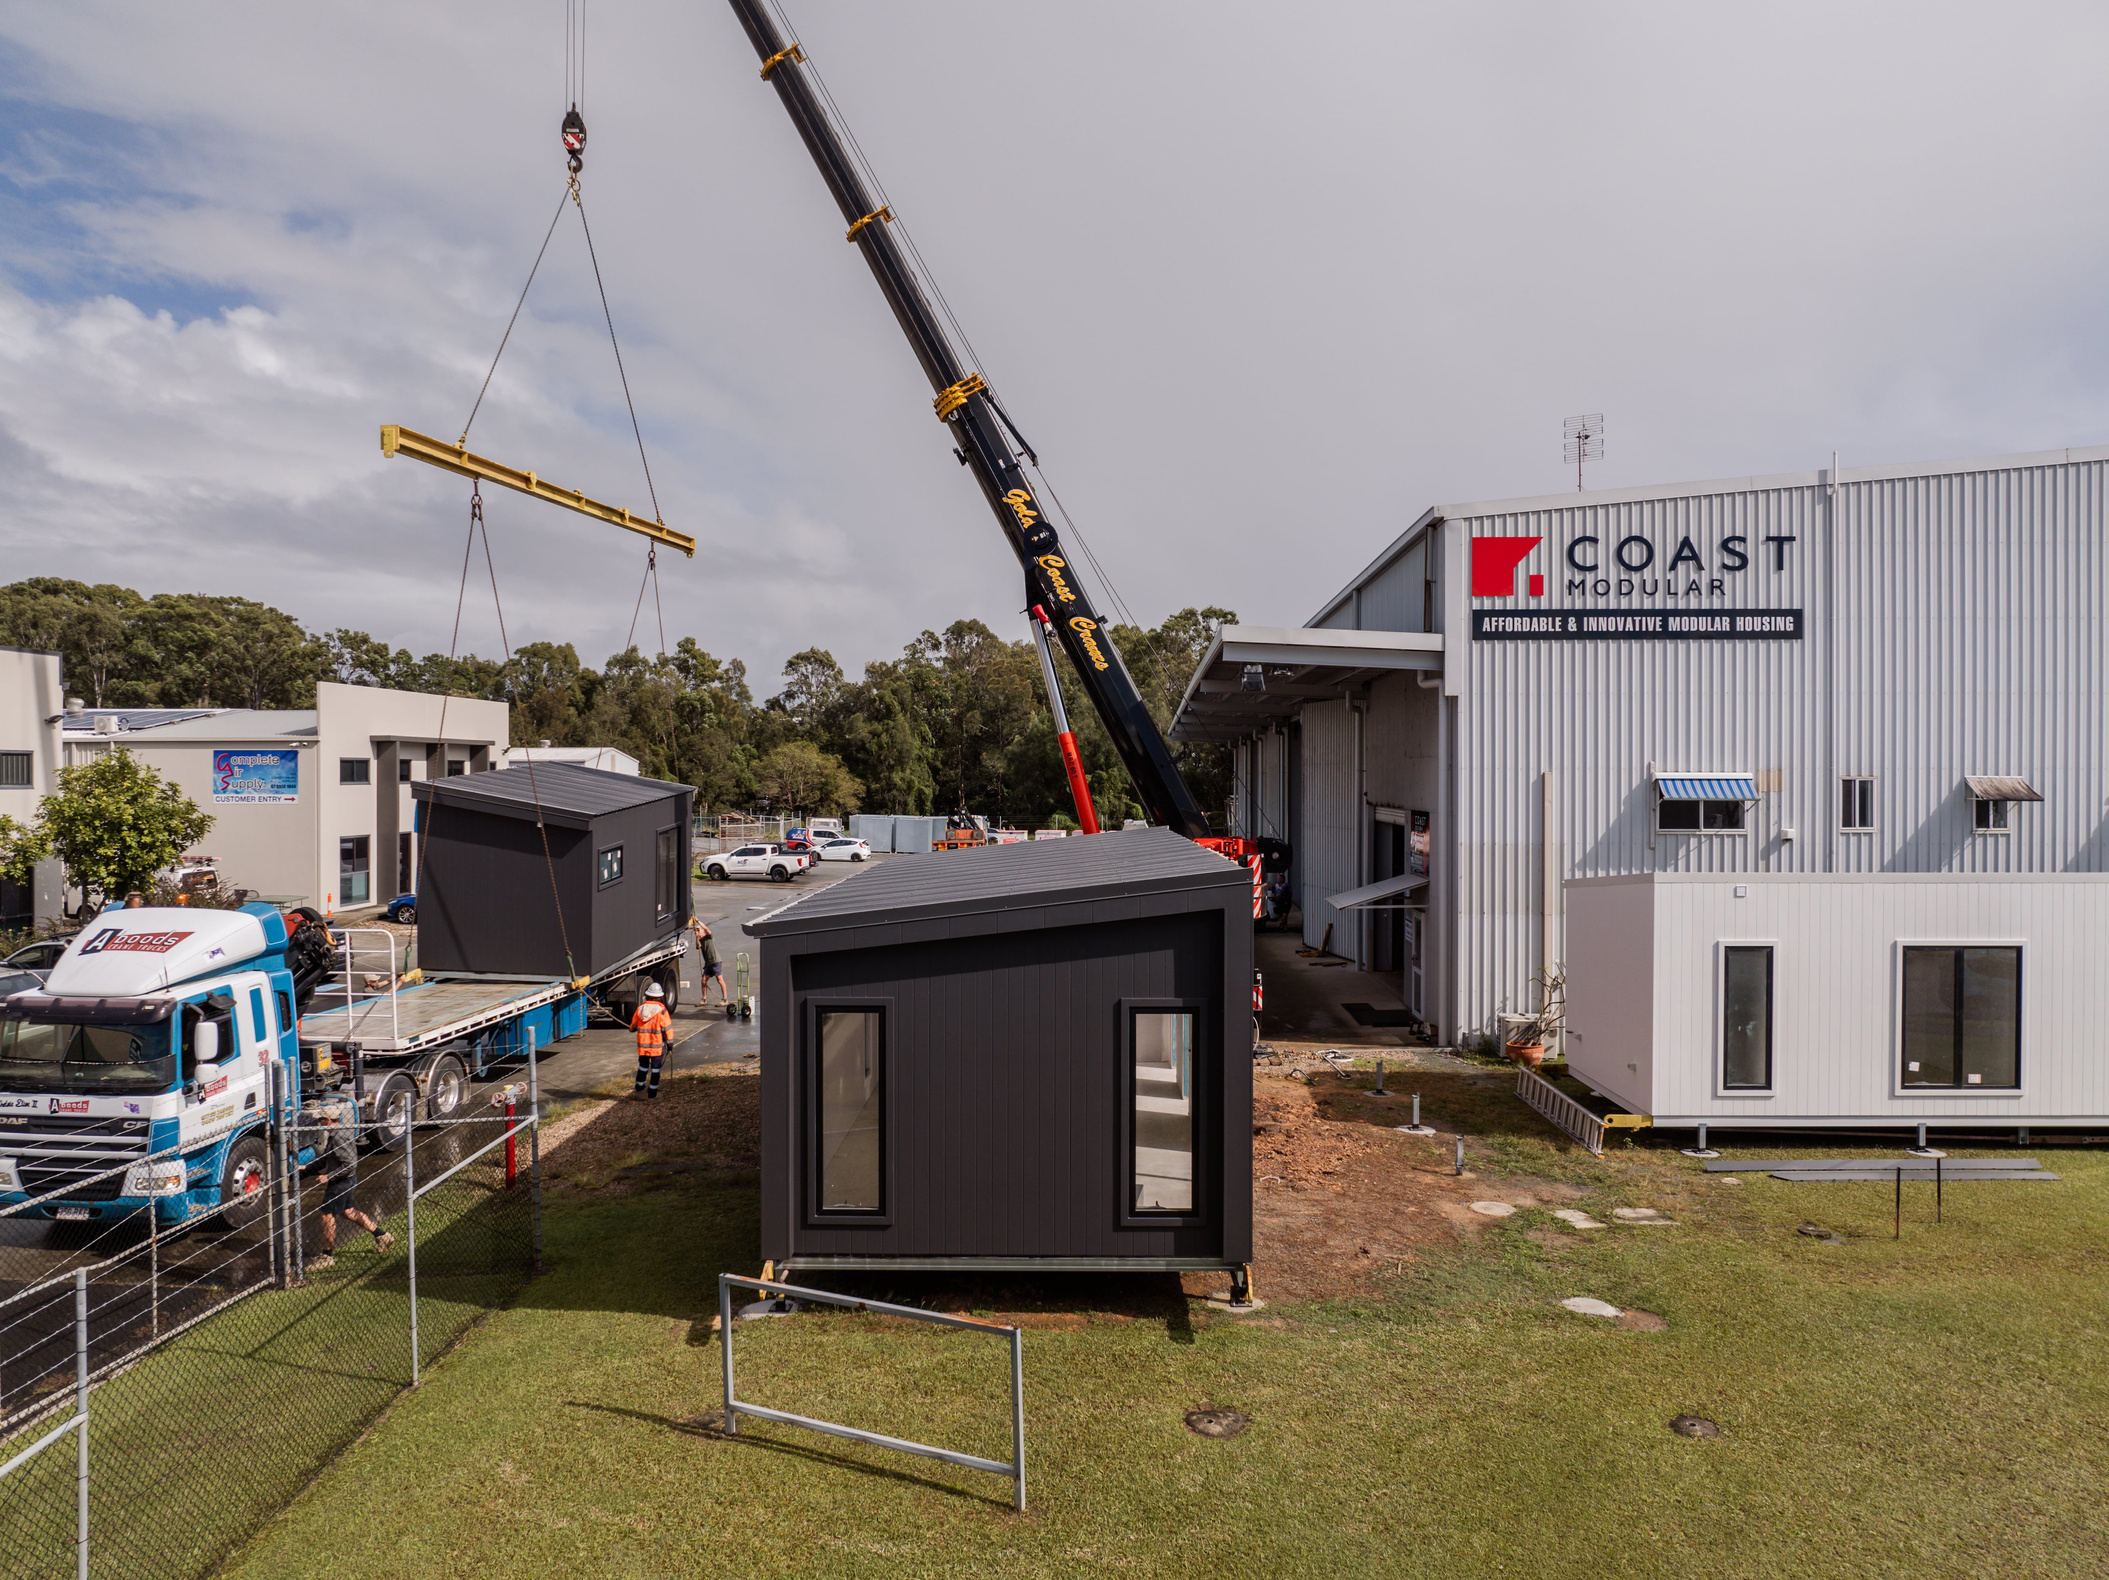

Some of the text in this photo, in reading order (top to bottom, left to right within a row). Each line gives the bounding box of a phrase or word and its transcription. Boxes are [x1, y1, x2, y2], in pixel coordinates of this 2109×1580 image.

[1567, 535, 1797, 573] COAST
[1568, 578, 1727, 596] MODULAR
[1039, 554, 1076, 602] Coast
[1069, 616, 1110, 672] Cranes
[1482, 616, 1794, 632] AFFORDABLE & INNOVATIVE MODULAR HOUSING
[217, 753, 280, 771] Complete
[221, 774, 264, 791] Supply
[86, 929, 180, 950] Aboods
[136, 944, 169, 952] TRUCKS
[258, 1049, 270, 1067] 32
[0, 1117, 28, 1125] DAF
